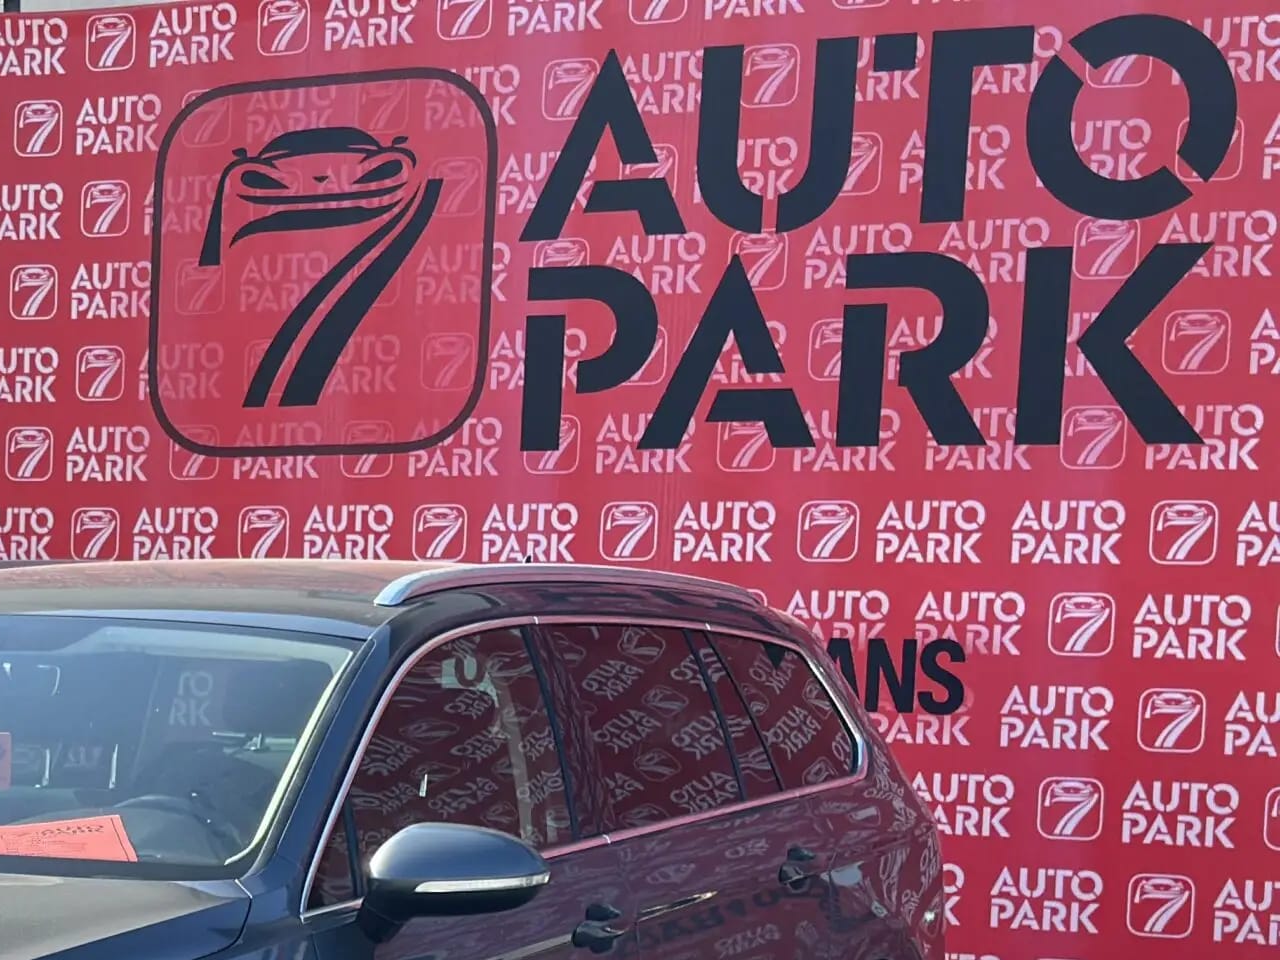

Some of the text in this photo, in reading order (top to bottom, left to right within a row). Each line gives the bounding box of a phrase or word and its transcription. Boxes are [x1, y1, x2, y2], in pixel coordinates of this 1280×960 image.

[148, 4, 237, 37] AUTO
[324, 13, 415, 51] PARK
[507, 0, 604, 37] PARK
[148, 31, 235, 68] PARK
[75, 93, 161, 126] AUTO
[75, 122, 158, 155] PARK
[519, 13, 1238, 242] AUTO
[804, 222, 912, 256] AUTO
[937, 216, 1050, 251] AUTO
[1157, 209, 1277, 244] AUTO
[604, 230, 706, 265] AUTO
[69, 260, 151, 290] AUTO
[70, 288, 151, 319] PARK
[520, 241, 1215, 452] PARK
[65, 425, 150, 453] AUTO
[924, 439, 1033, 471] PARK
[1144, 438, 1261, 471] PARK
[65, 453, 147, 482] PARK
[407, 447, 499, 477] PARK
[595, 442, 692, 474] PARK
[792, 440, 897, 473] PARK
[132, 505, 218, 533] AUTO
[303, 503, 393, 532] AUTO
[481, 502, 578, 531] AUTO
[673, 499, 776, 531] AUTO
[875, 499, 986, 531] AUTO
[1010, 499, 1126, 531] AUTO
[133, 534, 215, 561] PARK
[304, 533, 392, 561] PARK
[481, 532, 574, 563] PARK
[672, 531, 773, 562] PARK
[875, 531, 982, 564] PARK
[1010, 531, 1122, 564] PARK
[785, 589, 891, 621] AUTO
[913, 590, 1026, 623] AUTO
[1132, 592, 1251, 627] AUTO
[1132, 625, 1247, 661] PARK
[999, 684, 1114, 717] AUTO
[999, 715, 1110, 751] PARK
[911, 770, 1015, 805] AUTO
[1121, 779, 1239, 815] AUTO
[1121, 811, 1236, 848] PARK
[989, 865, 1103, 901] AUTO
[989, 896, 1100, 934] PARK
